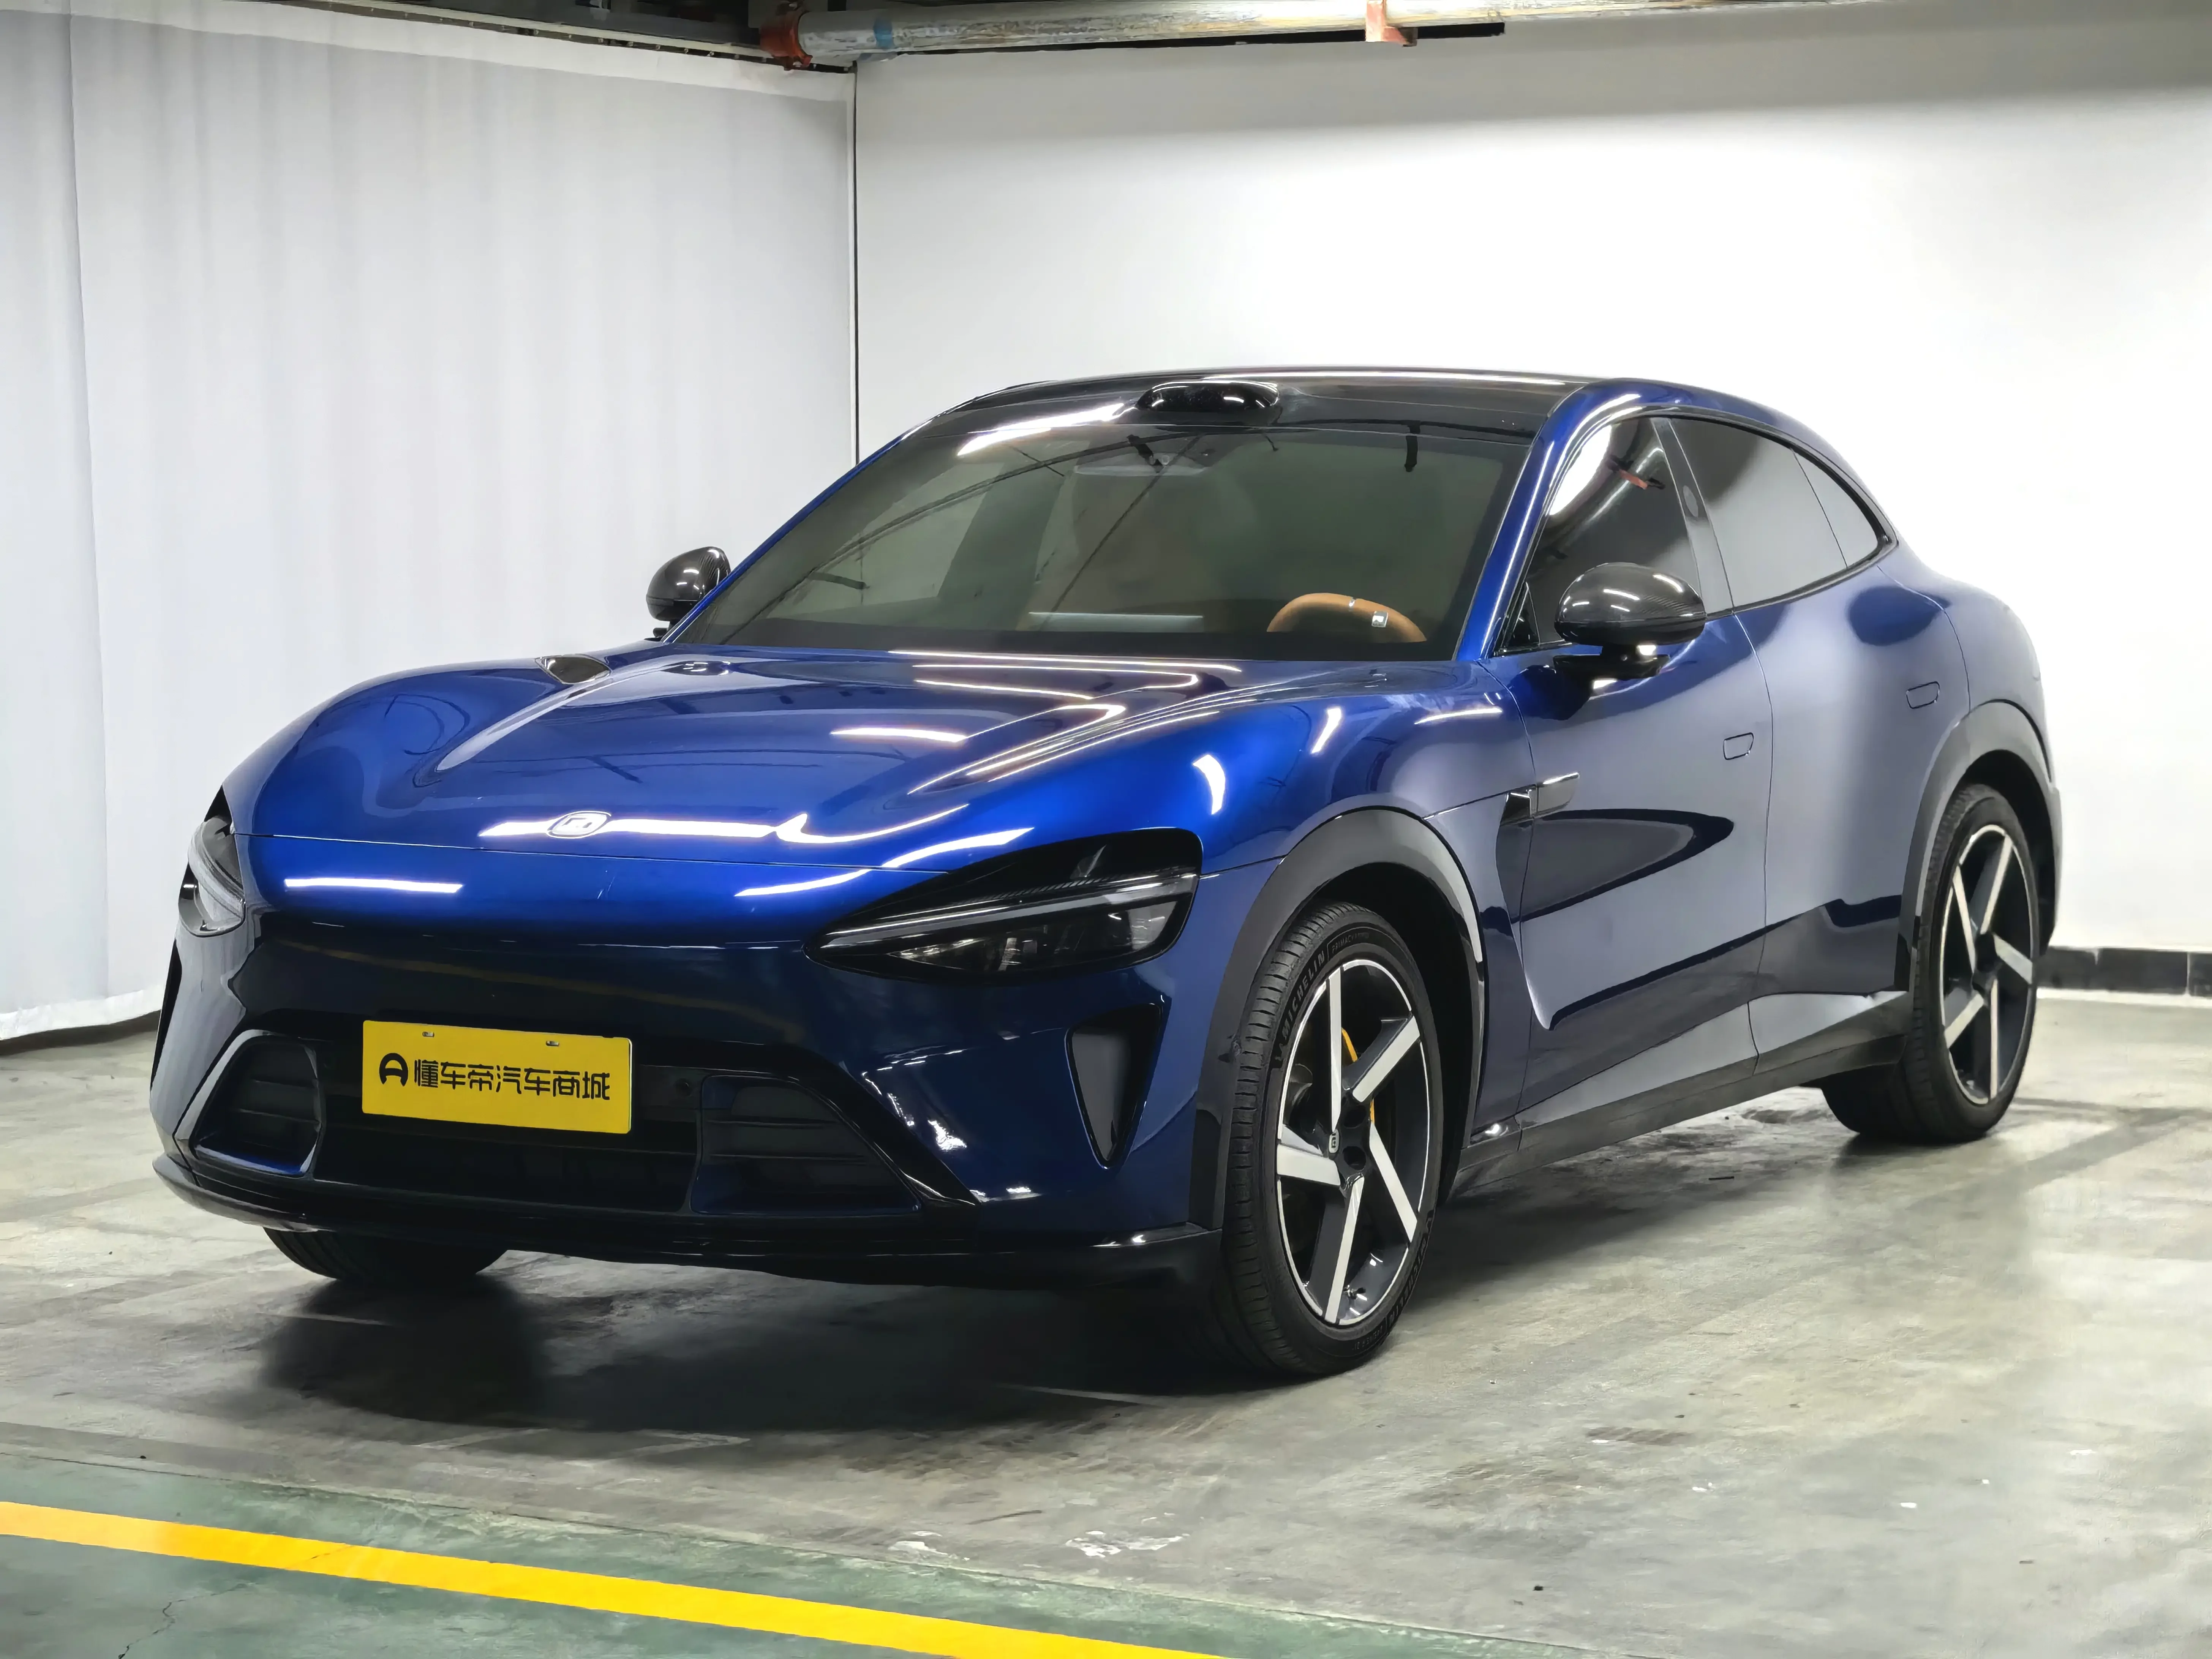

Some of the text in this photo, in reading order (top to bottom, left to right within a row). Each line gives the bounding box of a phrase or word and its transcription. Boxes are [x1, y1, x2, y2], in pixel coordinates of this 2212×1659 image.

[1282, 950, 1325, 1041] MICHELIN
[414, 1059, 610, 1100] 懂车帝汽车商城
